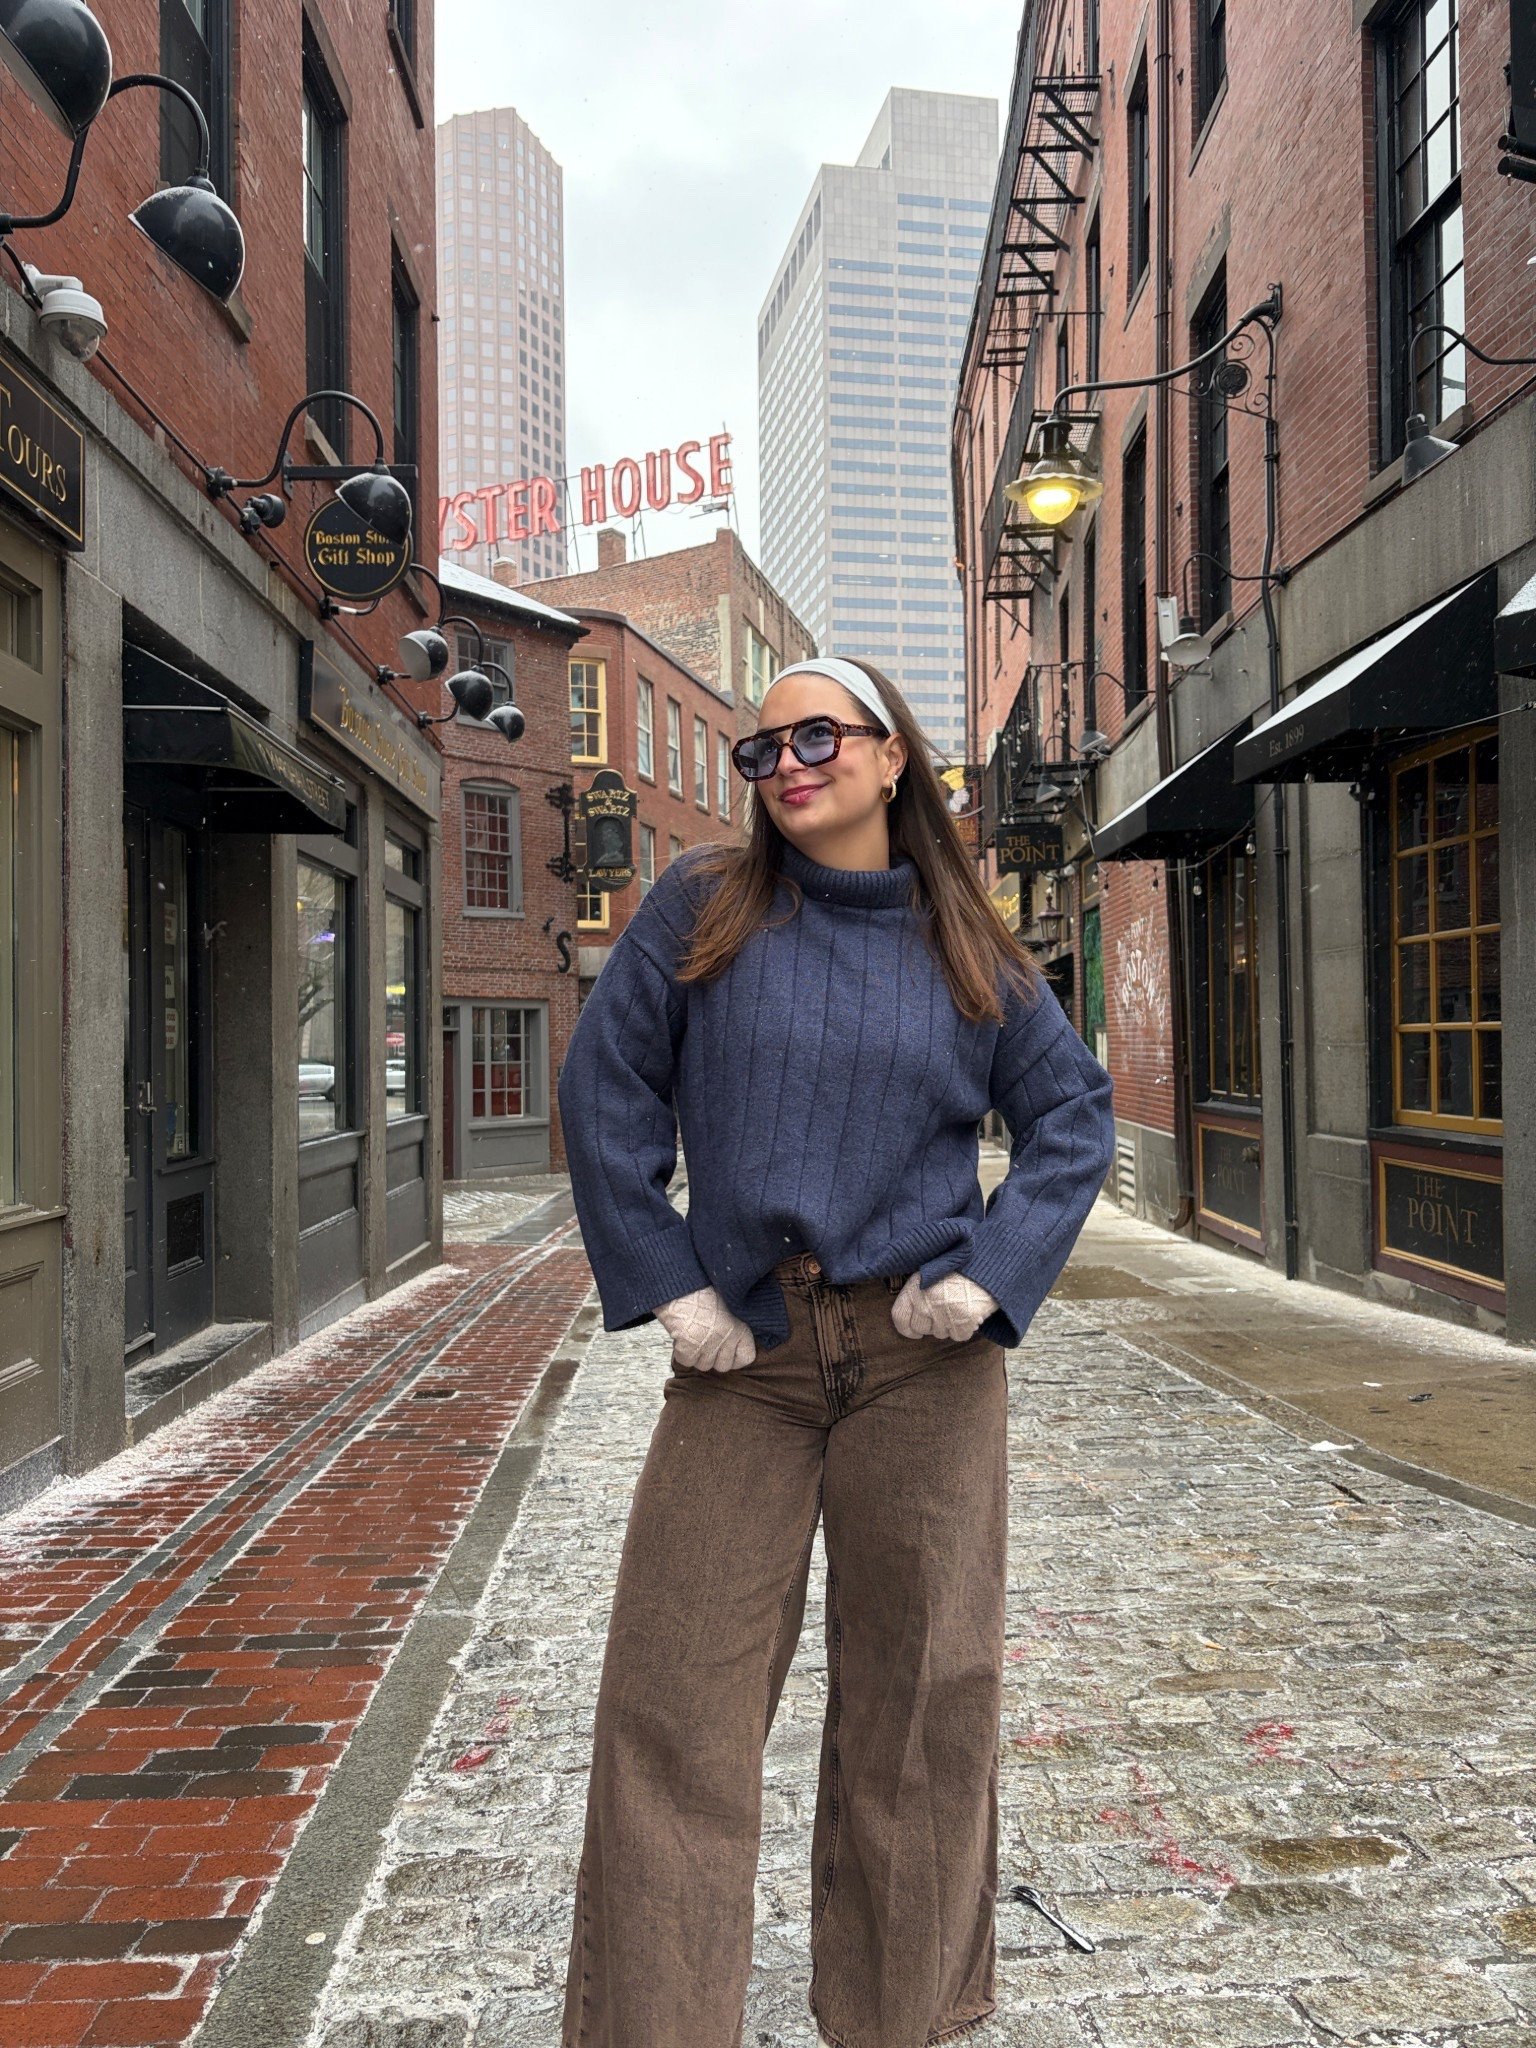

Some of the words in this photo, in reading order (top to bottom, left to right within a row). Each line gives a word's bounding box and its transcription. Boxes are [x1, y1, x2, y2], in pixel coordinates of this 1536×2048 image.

[581, 433, 733, 526] HOUSE
[313, 530, 360, 545] Boston
[365, 530, 393, 545] Sto
[318, 547, 349, 566] Gift
[356, 547, 395, 567] Shop
[1269, 740, 1283, 757] Est.
[1285, 724, 1305, 750] 1899
[586, 788, 630, 802] SWARTZ
[605, 798, 613, 806] &
[588, 805, 630, 817] SWARTZ
[1006, 836, 1030, 847] THE
[1000, 842, 1059, 864] POINT
[588, 867, 632, 878] LAWYERS
[1217, 1164, 1247, 1195] POINT
[1413, 1174, 1443, 1199] THE
[1408, 1187, 1478, 1245] POINT
